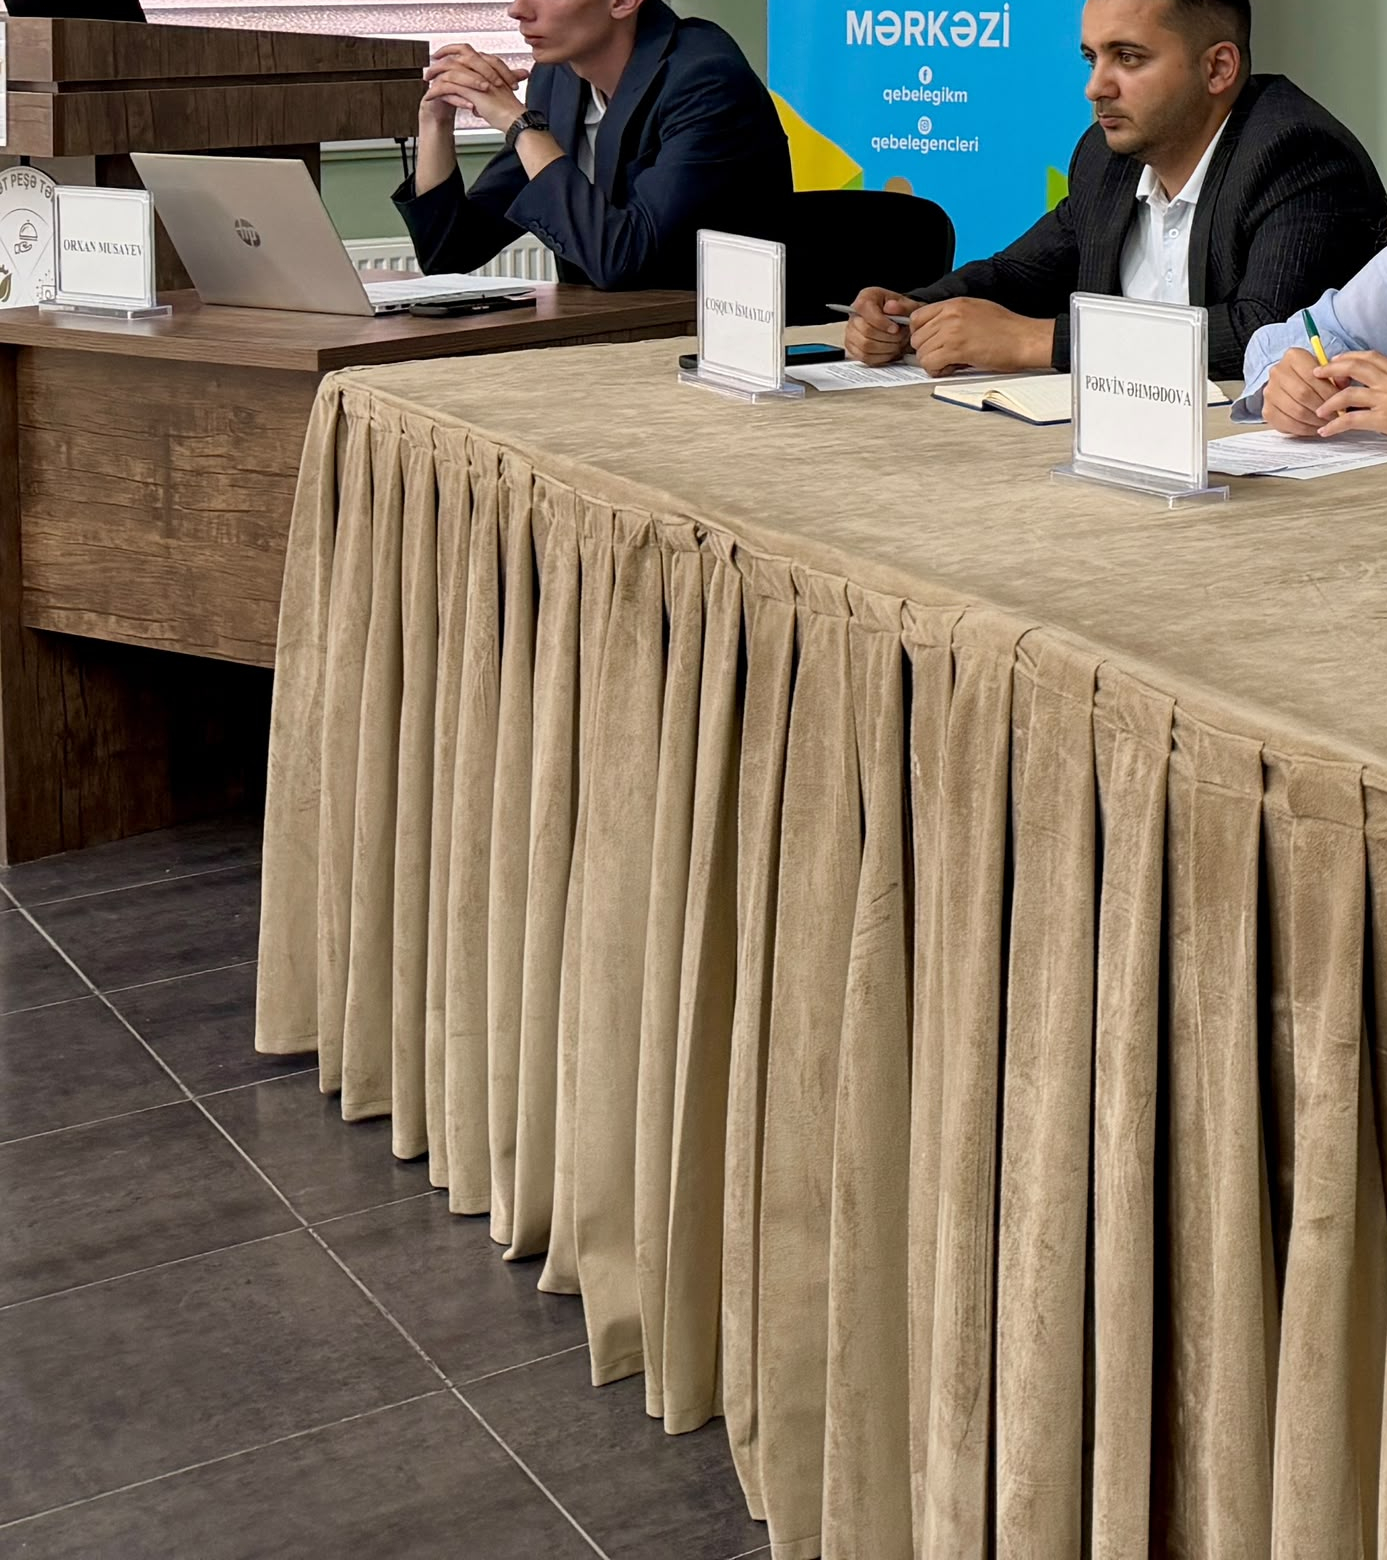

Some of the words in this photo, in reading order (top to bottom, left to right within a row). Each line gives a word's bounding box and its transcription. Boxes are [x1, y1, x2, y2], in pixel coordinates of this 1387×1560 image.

[846, 2, 1010, 48] MƏRKƏZİ
[882, 85, 968, 106] qebelegikm
[871, 133, 979, 155] qebelegencleri
[10, 172, 37, 190] PEŞƏ
[63, 238, 96, 253] ORXAN
[705, 296, 734, 317] COŞQUN
[1085, 374, 1125, 396] PƏRVİN
[1127, 381, 1192, 407] ƏHMƏDOVA
